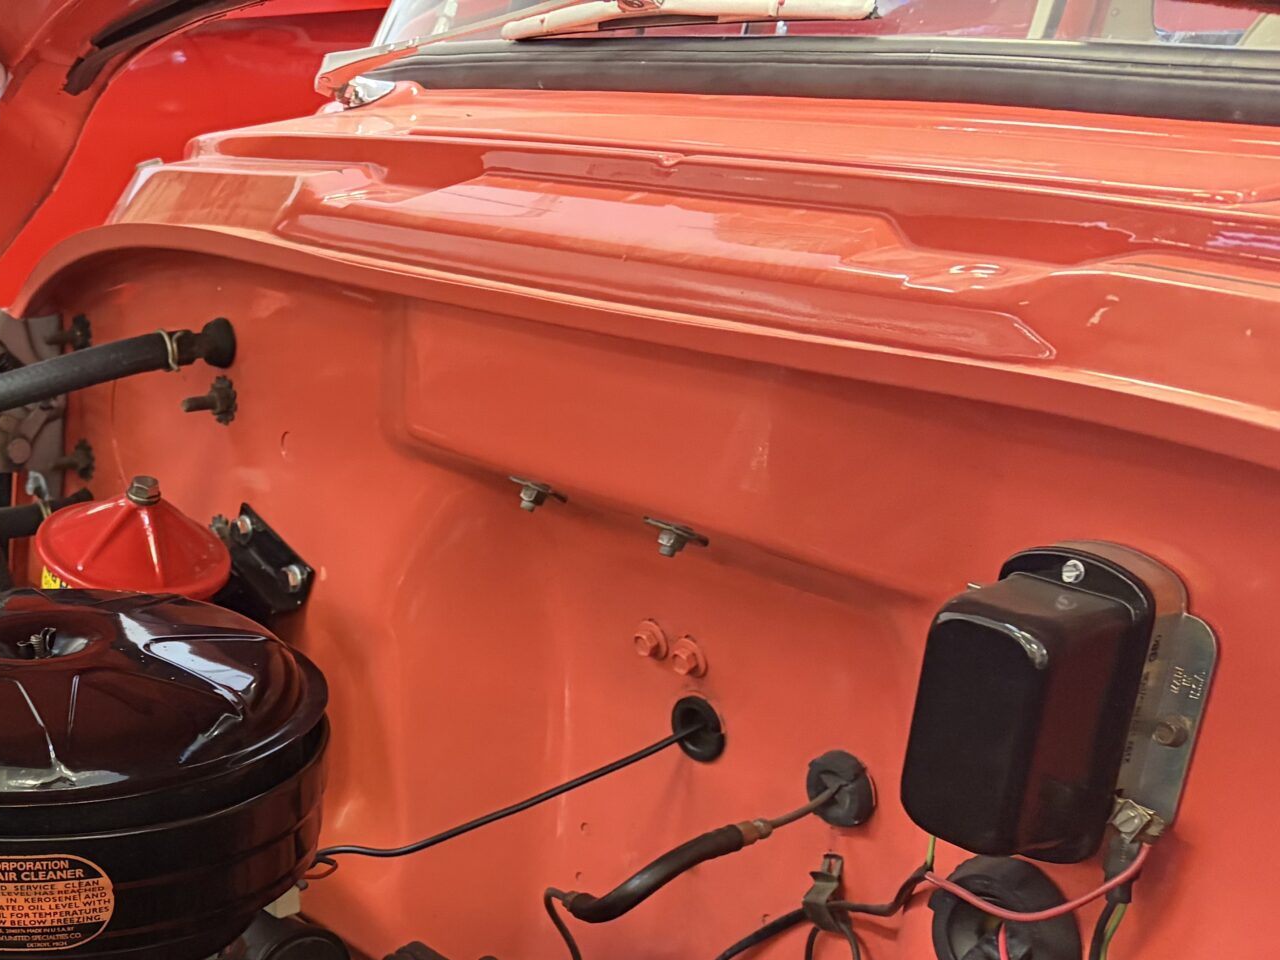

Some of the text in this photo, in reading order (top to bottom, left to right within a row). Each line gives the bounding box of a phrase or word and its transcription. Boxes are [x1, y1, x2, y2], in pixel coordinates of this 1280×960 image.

[21, 868, 85, 881] CLEANER
[57, 886, 105, 895] REACHED
[64, 880, 100, 889] CLEAN
[24, 894, 79, 903] KEROSENE
[84, 891, 107, 900] AND
[48, 901, 80, 910] LEVEL
[82, 898, 111, 908] WITH
[32, 906, 110, 919] TEMPERATURES
[10, 919, 47, 927] BELOW
